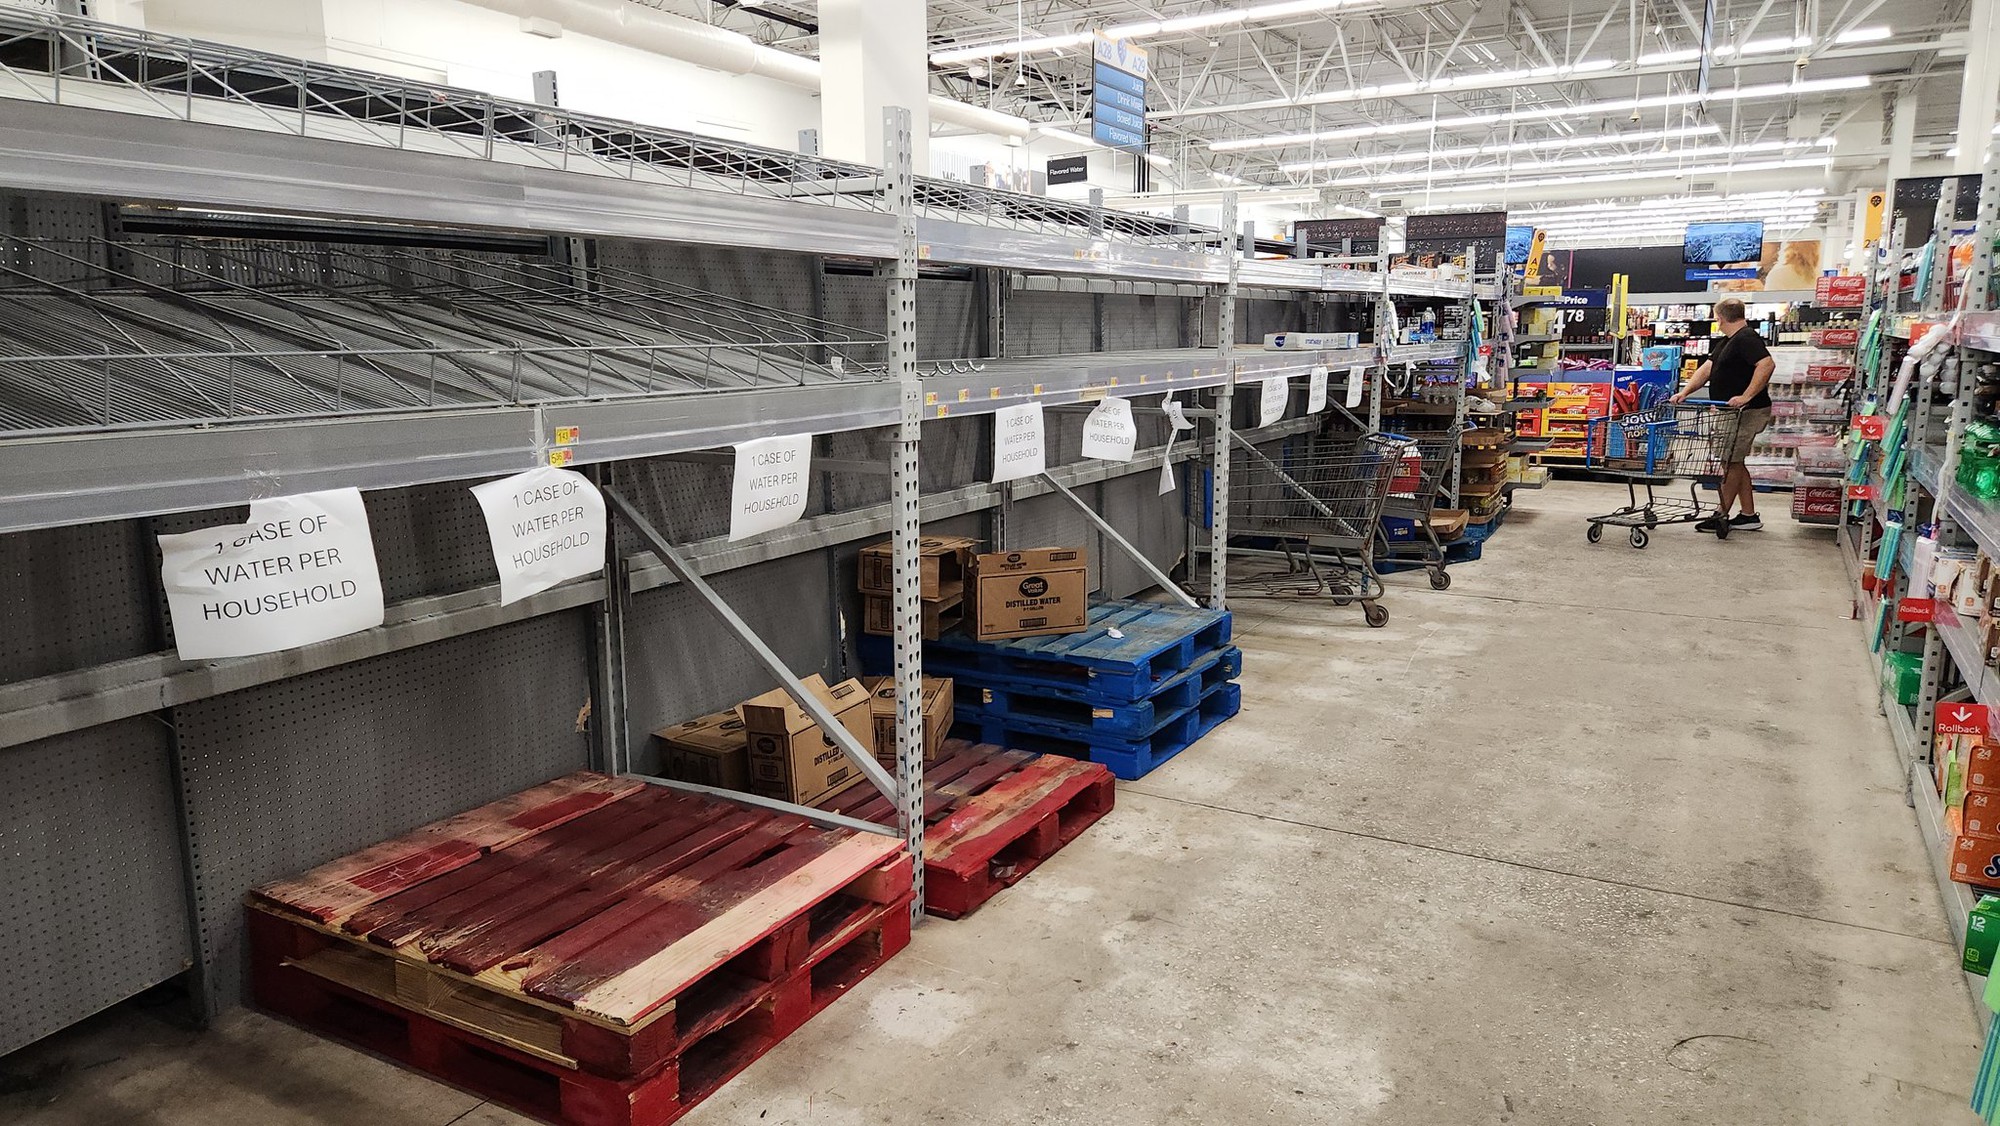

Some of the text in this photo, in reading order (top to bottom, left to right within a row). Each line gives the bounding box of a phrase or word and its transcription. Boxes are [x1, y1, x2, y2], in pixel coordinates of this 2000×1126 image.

[1117, 92, 1131, 106] Drink
[1050, 167, 1070, 176] Flavored
[1530, 257, 1538, 265] A
[1527, 268, 1537, 276] 27
[1563, 295, 1588, 305] Price
[1089, 432, 1130, 445] HOUSEHOLD
[757, 451, 782, 466] CASE
[783, 449, 796, 463] OF
[1002, 447, 1038, 463] HOUSEHOLD
[749, 471, 798, 491] WATER PER
[513, 480, 580, 509] 1 CASE OF
[743, 493, 800, 515] HOUSEHOLD
[299, 514, 328, 535] OF
[512, 506, 584, 538] WATER PER
[512, 531, 590, 569] HOUSEHOLD
[204, 547, 342, 585] WATER PER
[1022, 581, 1044, 590] Great
[202, 579, 357, 621] HOUSEHOLD
[1005, 596, 1061, 609] DISTILLED WATER
[1900, 605, 1930, 615] Rollback
[1938, 723, 1981, 735] Rollback
[814, 746, 840, 767] DISTILLED
[1977, 748, 1993, 758] 24
[1974, 794, 1989, 805] 24
[1960, 838, 1975, 849] 24
[1972, 915, 1987, 928] 12
